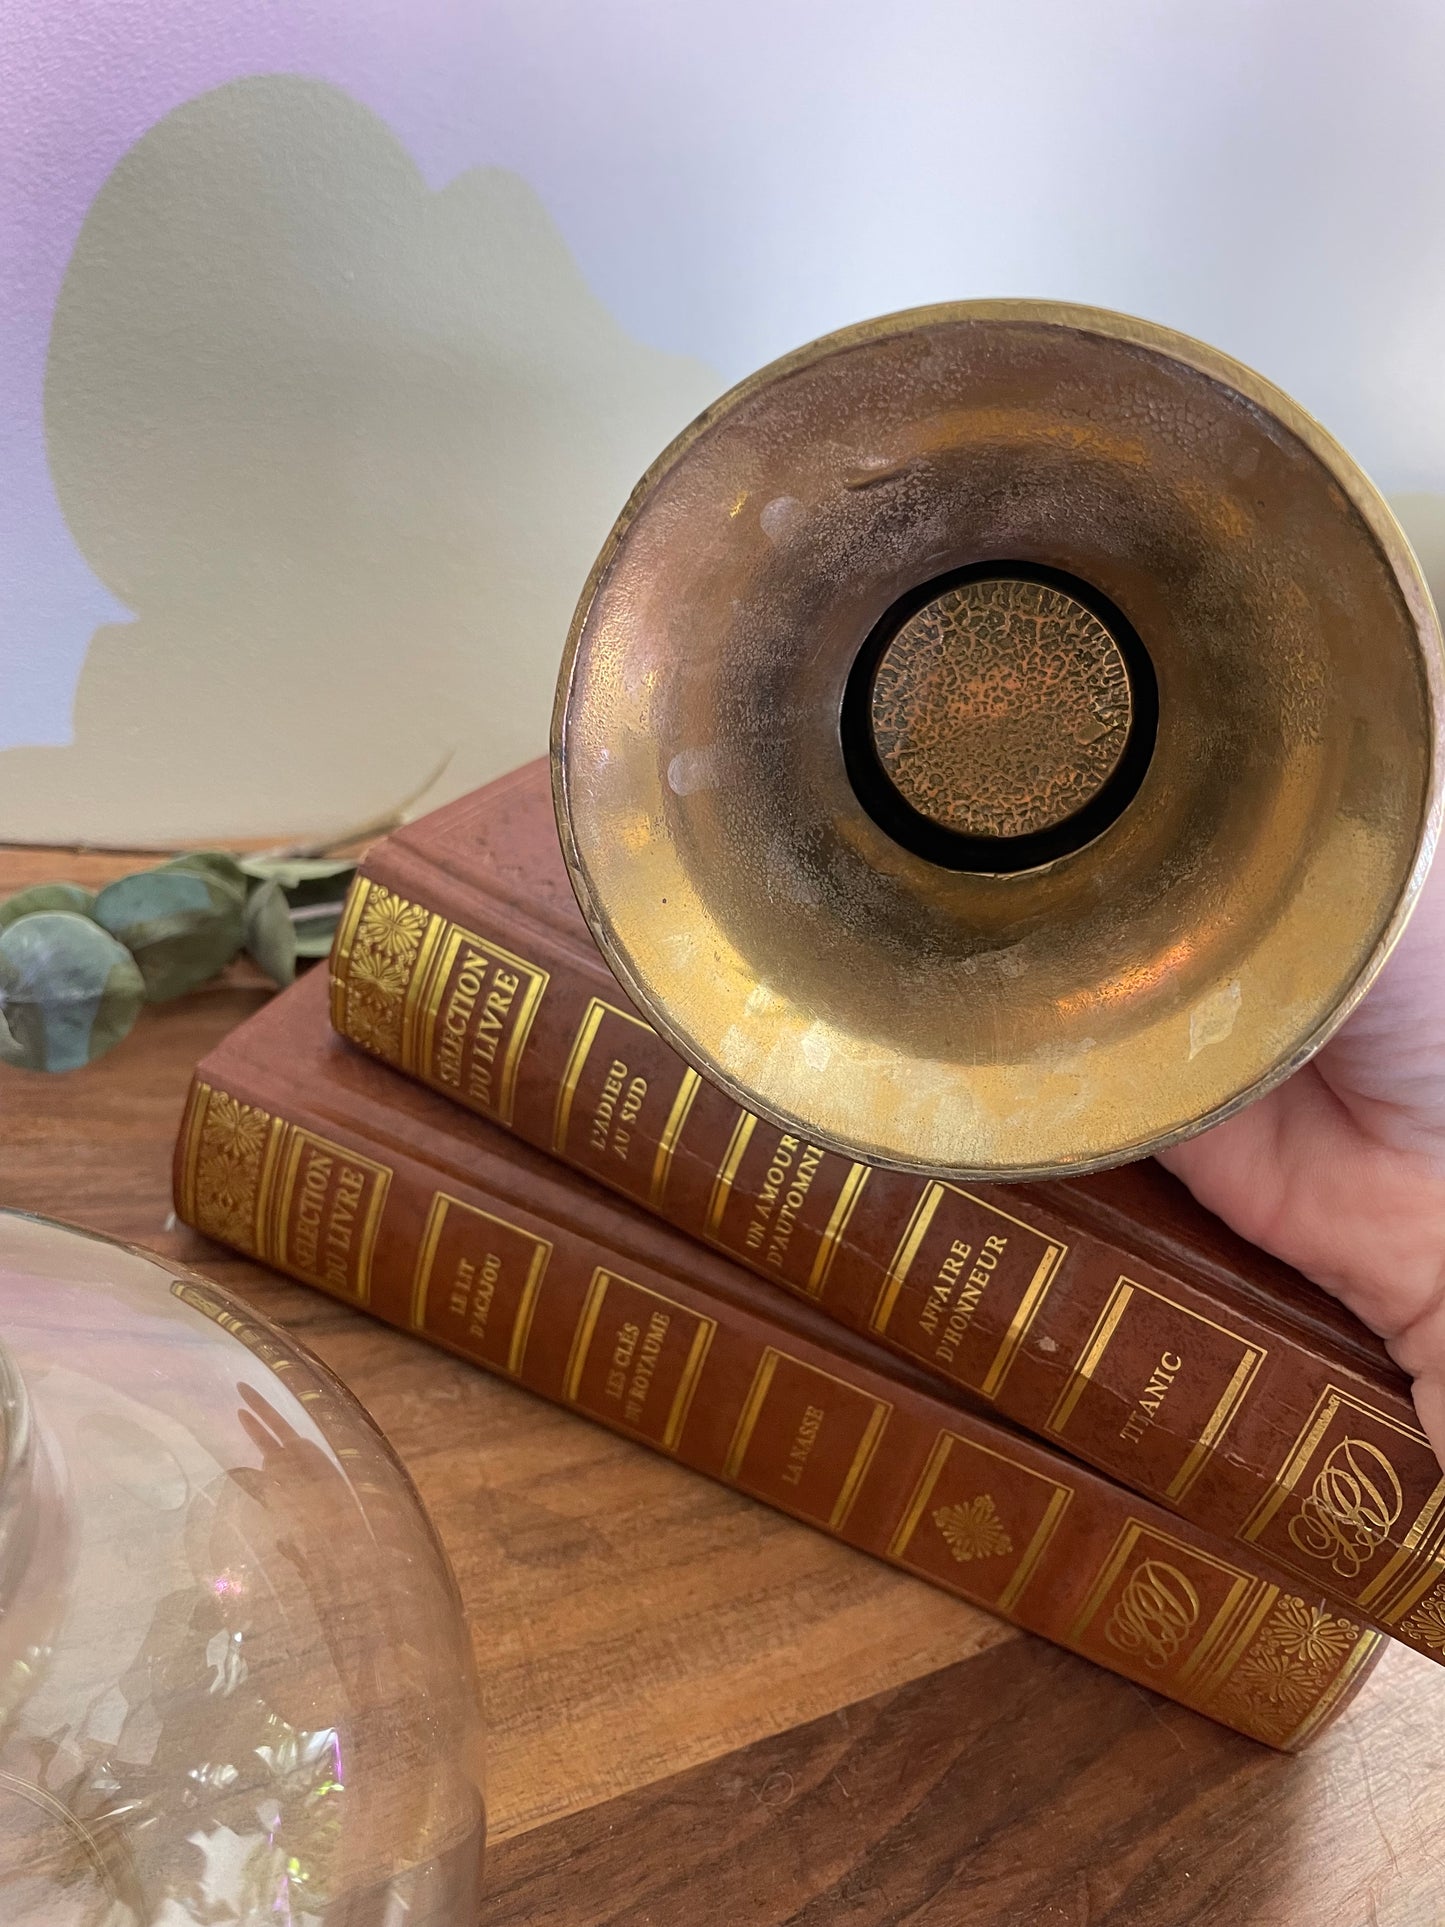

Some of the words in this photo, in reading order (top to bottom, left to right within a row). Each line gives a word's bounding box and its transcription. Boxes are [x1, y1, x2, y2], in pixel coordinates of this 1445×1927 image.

[473, 968, 519, 1064] LIVRE
[469, 1063, 493, 1105] DU
[590, 1059, 628, 1151] L'ADIEU
[622, 1077, 648, 1124] SUD
[614, 1128, 631, 1160] AU
[755, 1134, 800, 1221] AMOUR
[327, 1167, 364, 1253] LIVRE
[747, 1223, 764, 1249] UN
[325, 1251, 348, 1287] DU
[456, 1258, 476, 1291] LIT
[919, 1239, 972, 1336] AFFAIRE
[449, 1288, 467, 1317] LE
[470, 1252, 502, 1340] D'ACAJOU
[935, 1234, 1008, 1363] D'HONNEUR
[614, 1322, 640, 1367] CLÉS
[629, 1311, 670, 1400] ROYAUME
[605, 1369, 626, 1399] LES
[1119, 1351, 1182, 1444] TITANIC
[790, 1405, 824, 1463] NASSE
[782, 1462, 802, 1485] LA
